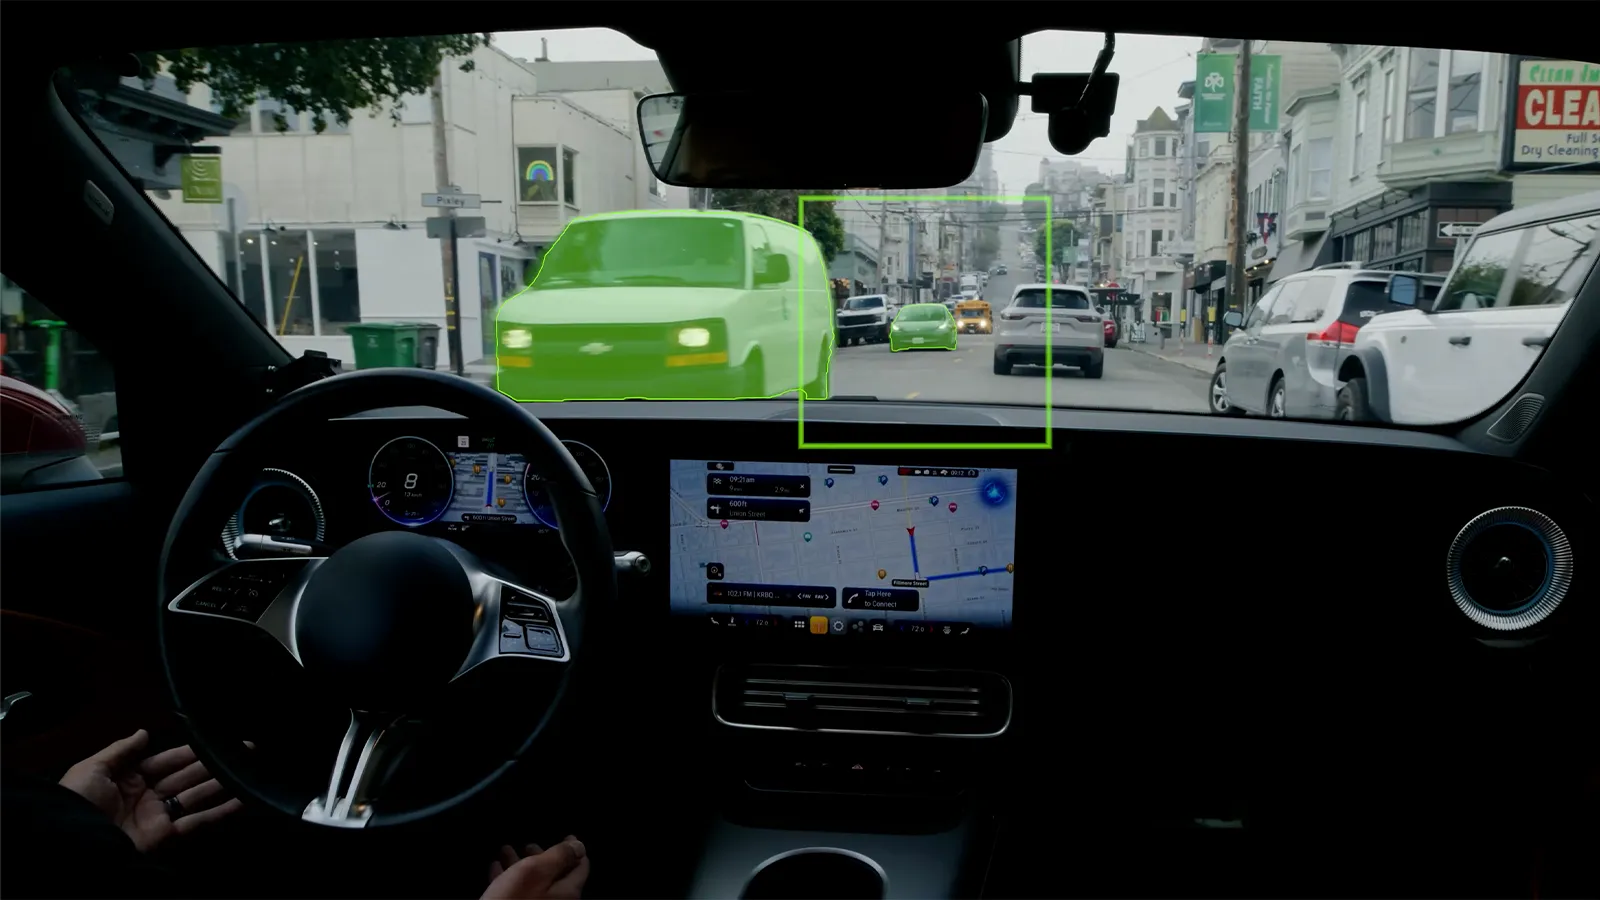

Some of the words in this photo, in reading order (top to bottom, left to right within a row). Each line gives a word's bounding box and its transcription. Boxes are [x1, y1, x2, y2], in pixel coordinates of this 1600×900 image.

[1566, 132, 1588, 144] Full
[1521, 145, 1542, 158] Dry
[1547, 144, 1599, 159] Cleaning
[437, 196, 465, 208] Pixley
[404, 473, 418, 489] 8
[729, 510, 746, 518] Union
[748, 510, 766, 518] Street
[865, 590, 876, 598] Tap
